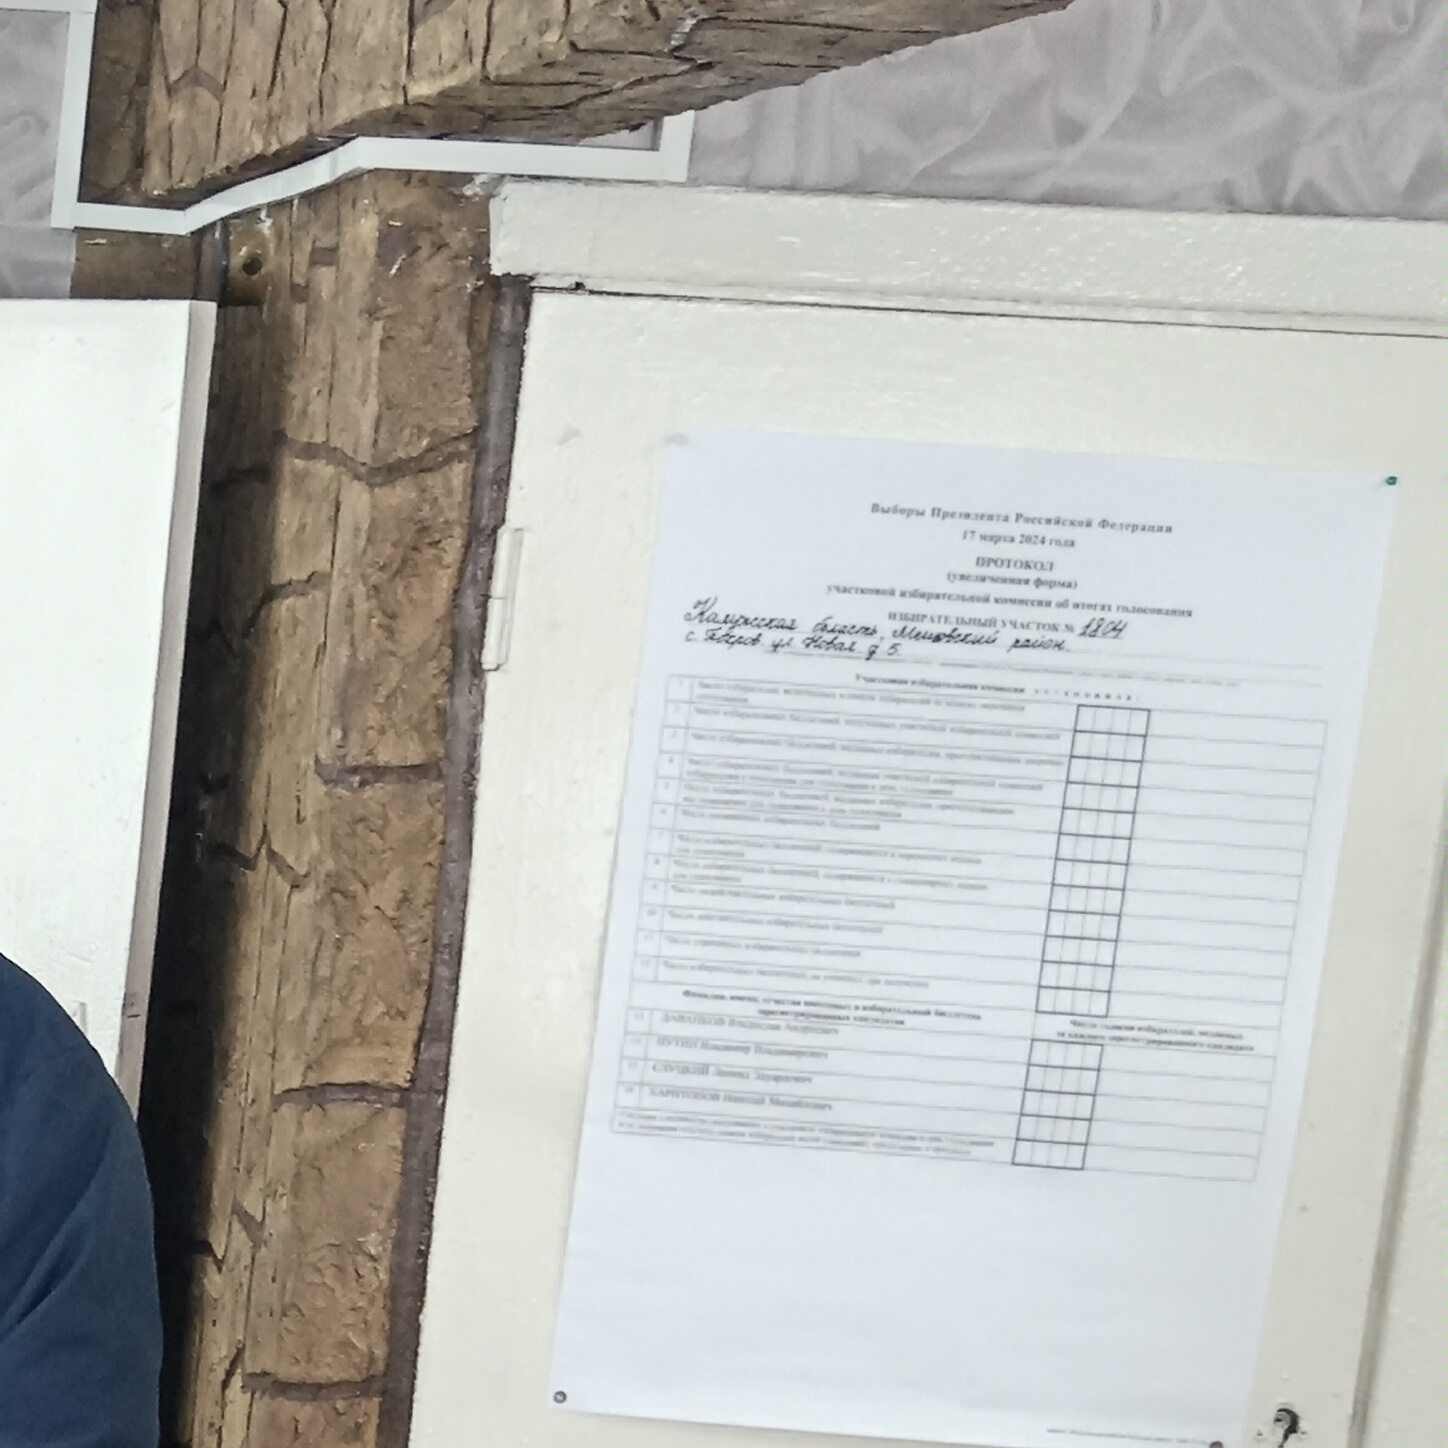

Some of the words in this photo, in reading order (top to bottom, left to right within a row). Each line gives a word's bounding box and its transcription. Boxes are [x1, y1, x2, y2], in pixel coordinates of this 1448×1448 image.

[870, 502, 926, 518] Выборы
[931, 506, 1010, 524] Президента
[1015, 512, 1093, 529] Российской
[1098, 518, 1173, 534] Федерации
[961, 530, 977, 542] 17
[979, 534, 1015, 547] марта
[1018, 533, 1046, 546] 2024
[1049, 537, 1076, 549] года
[975, 556, 1054, 572] ПРОТОКОЛ
[946, 571, 1030, 588] (увеличенная
[1032, 575, 1078, 590] форма)
[826, 584, 896, 599] участковой
[900, 587, 990, 605] избирательной
[993, 595, 1052, 608] комиссии
[1055, 597, 1069, 610] об
[1072, 601, 1112, 613] итогах
[1116, 604, 1193, 619] голосования
[888, 611, 997, 629] ИЗБИРАТЕЛЬНЫЙ
[1000, 618, 1062, 634] УЧАСТОК
[1065, 622, 1075, 634] №
[1077, 616, 1128, 639] 1804
